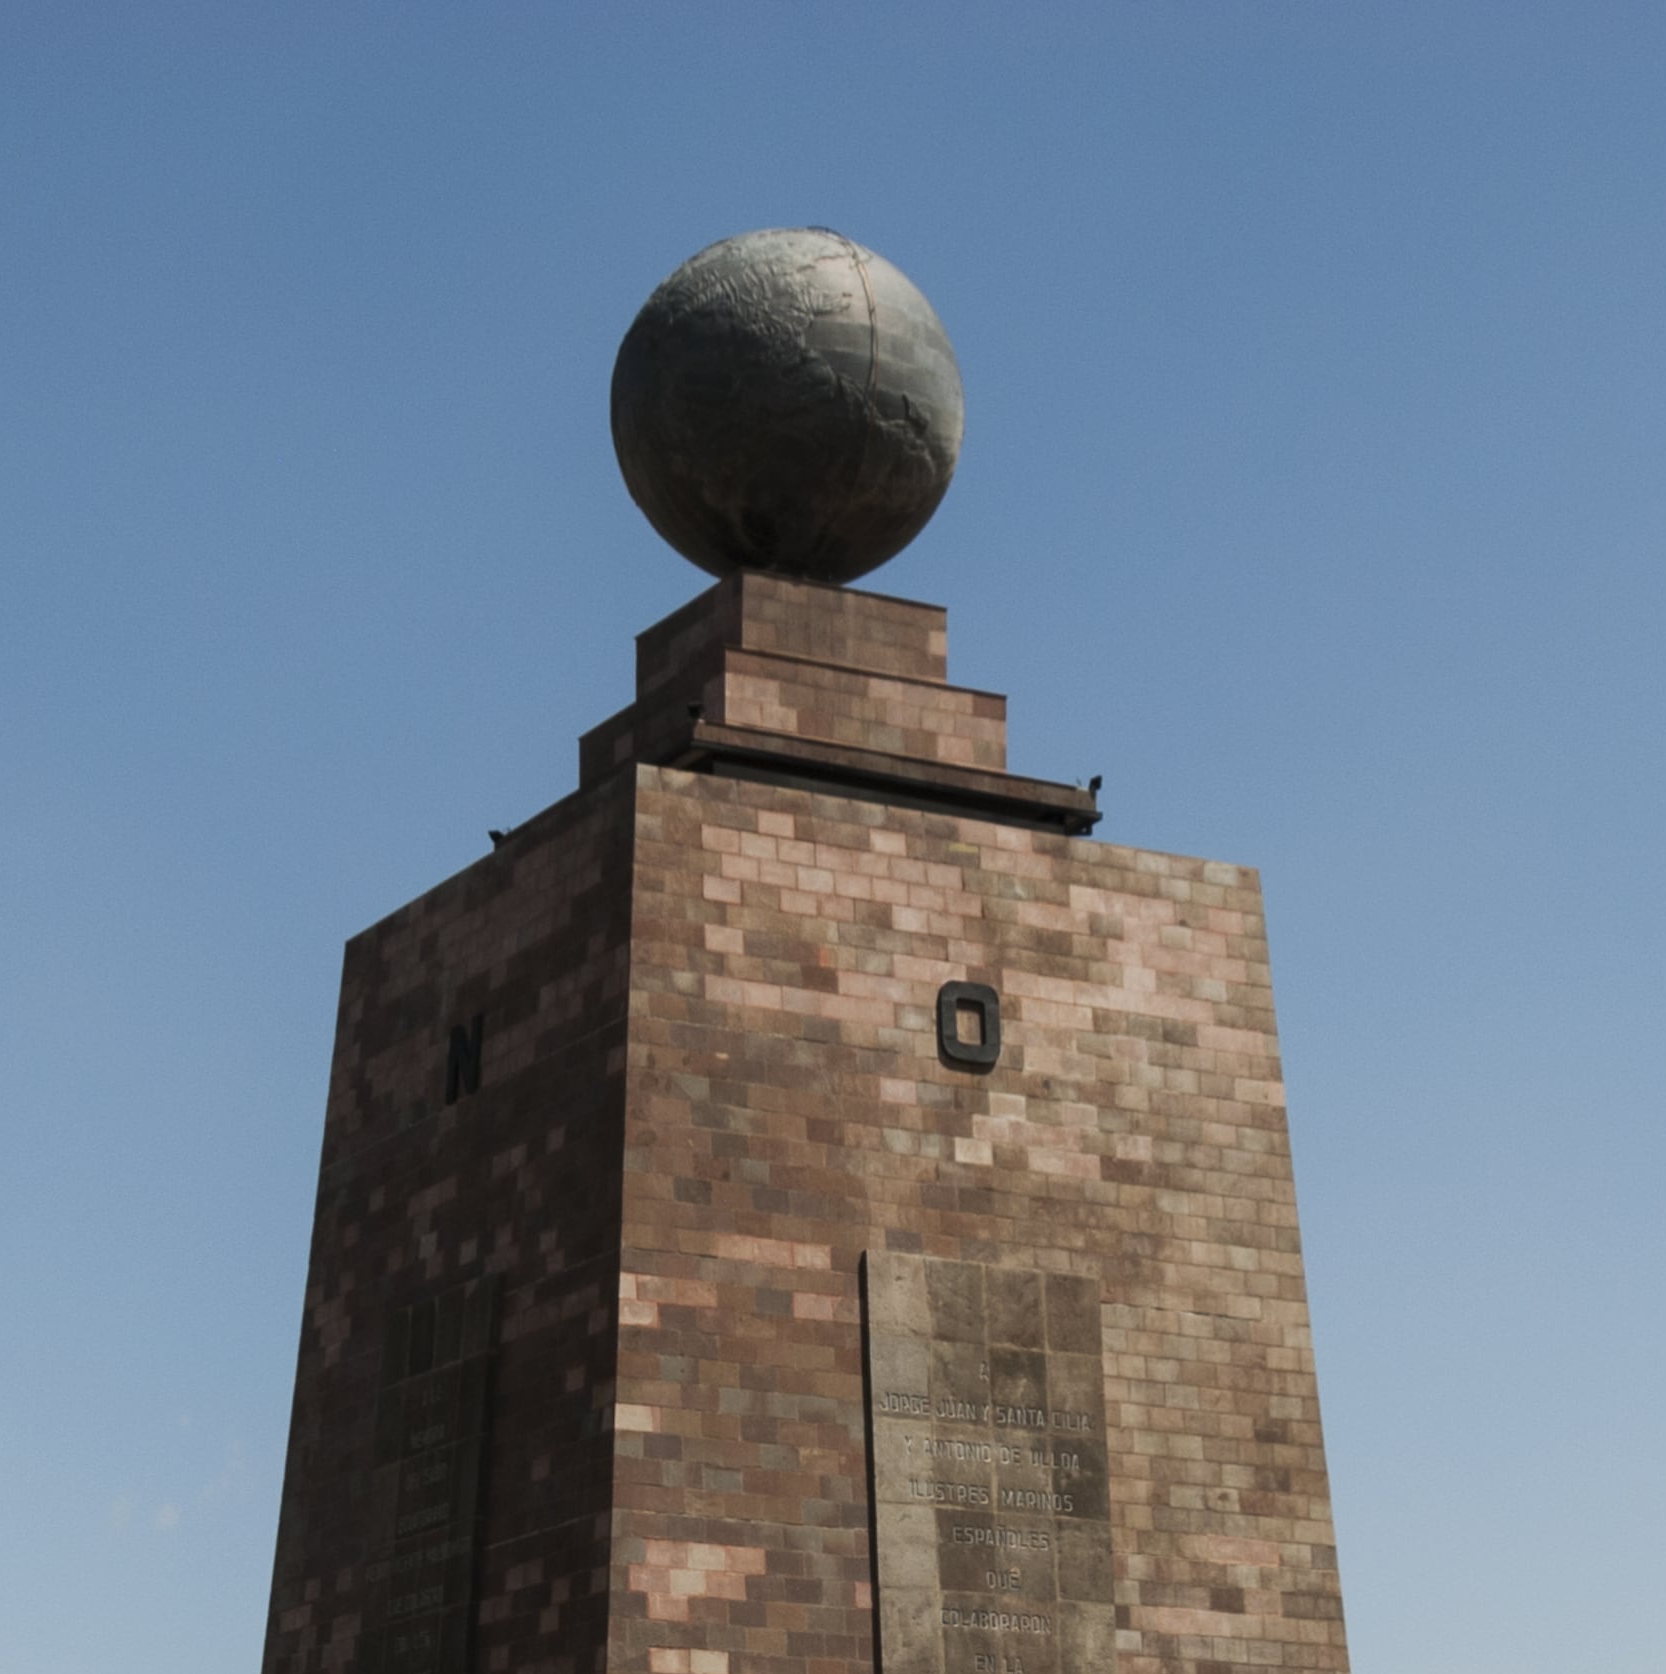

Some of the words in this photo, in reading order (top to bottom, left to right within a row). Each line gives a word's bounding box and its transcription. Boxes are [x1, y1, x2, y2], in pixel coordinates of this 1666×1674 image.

[879, 1392, 932, 1415] JORGE
[936, 1399, 976, 1420] JUAN
[982, 1404, 990, 1421] Y
[996, 1404, 1045, 1428] SANTA
[924, 1437, 992, 1463] ANTONIO
[999, 1445, 1021, 1466] DE
[1029, 1448, 1080, 1471] ULLOA
[909, 1479, 989, 1504] ILUSTRES
[1001, 1489, 1073, 1513] MARINOS
[941, 1608, 1051, 1634] COLABORARON
[975, 1653, 996, 1673] EN
[1004, 1657, 1024, 1674] LA
